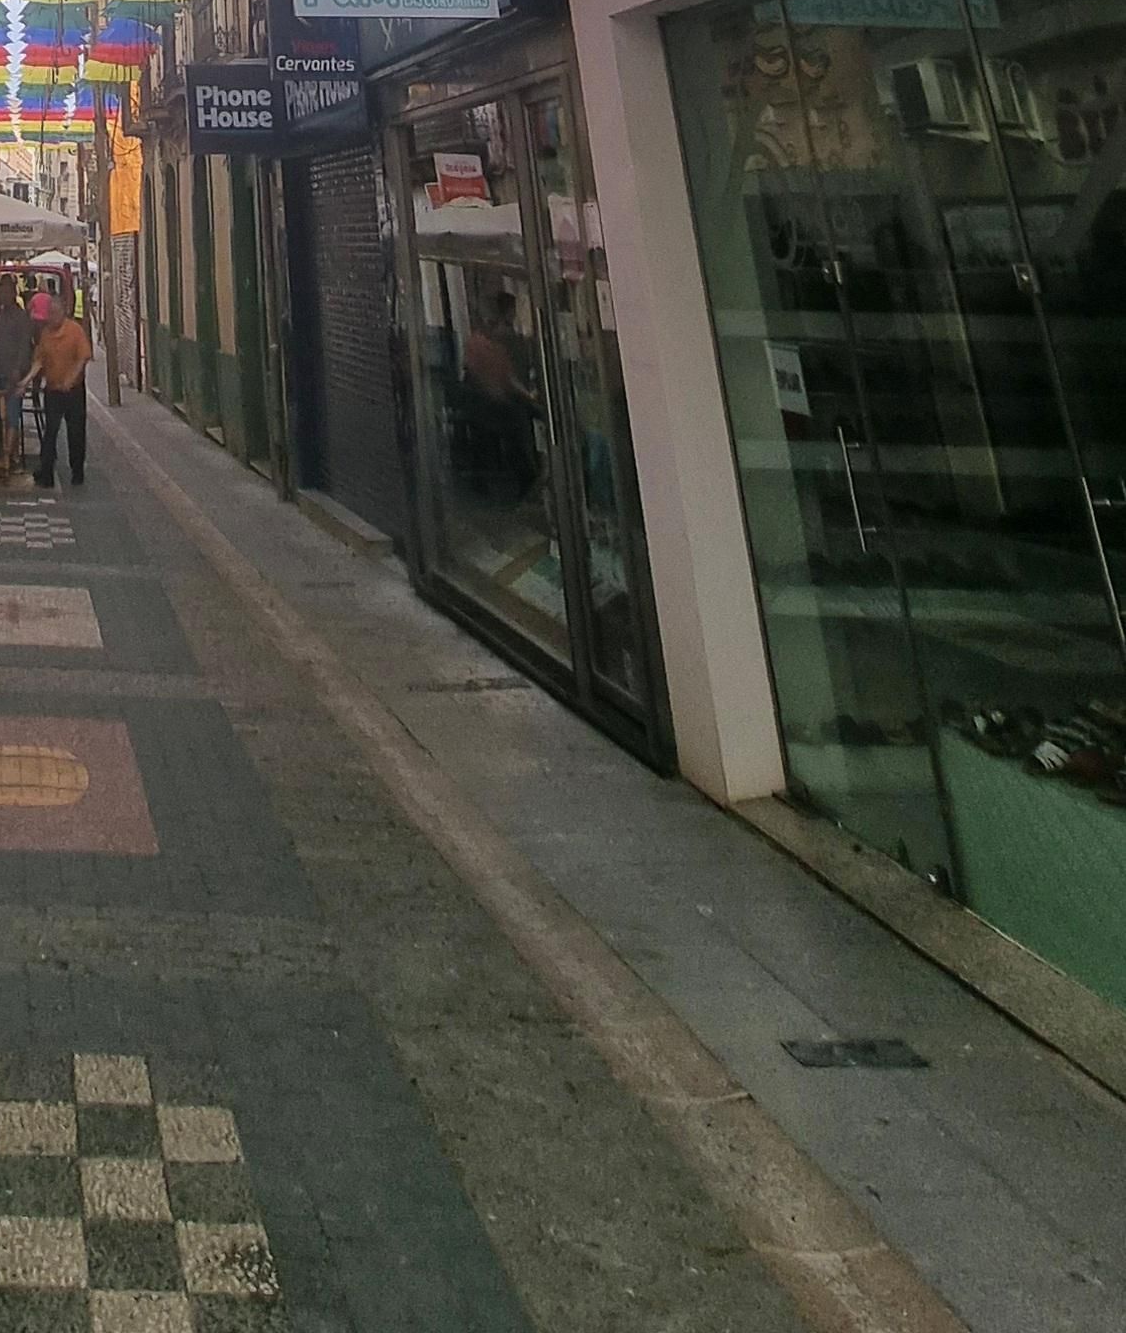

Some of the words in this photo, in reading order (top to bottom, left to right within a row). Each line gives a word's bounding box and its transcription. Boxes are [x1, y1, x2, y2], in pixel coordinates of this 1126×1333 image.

[276, 56, 355, 71] Cervantes
[196, 85, 272, 106] Phone
[197, 107, 273, 128] House
